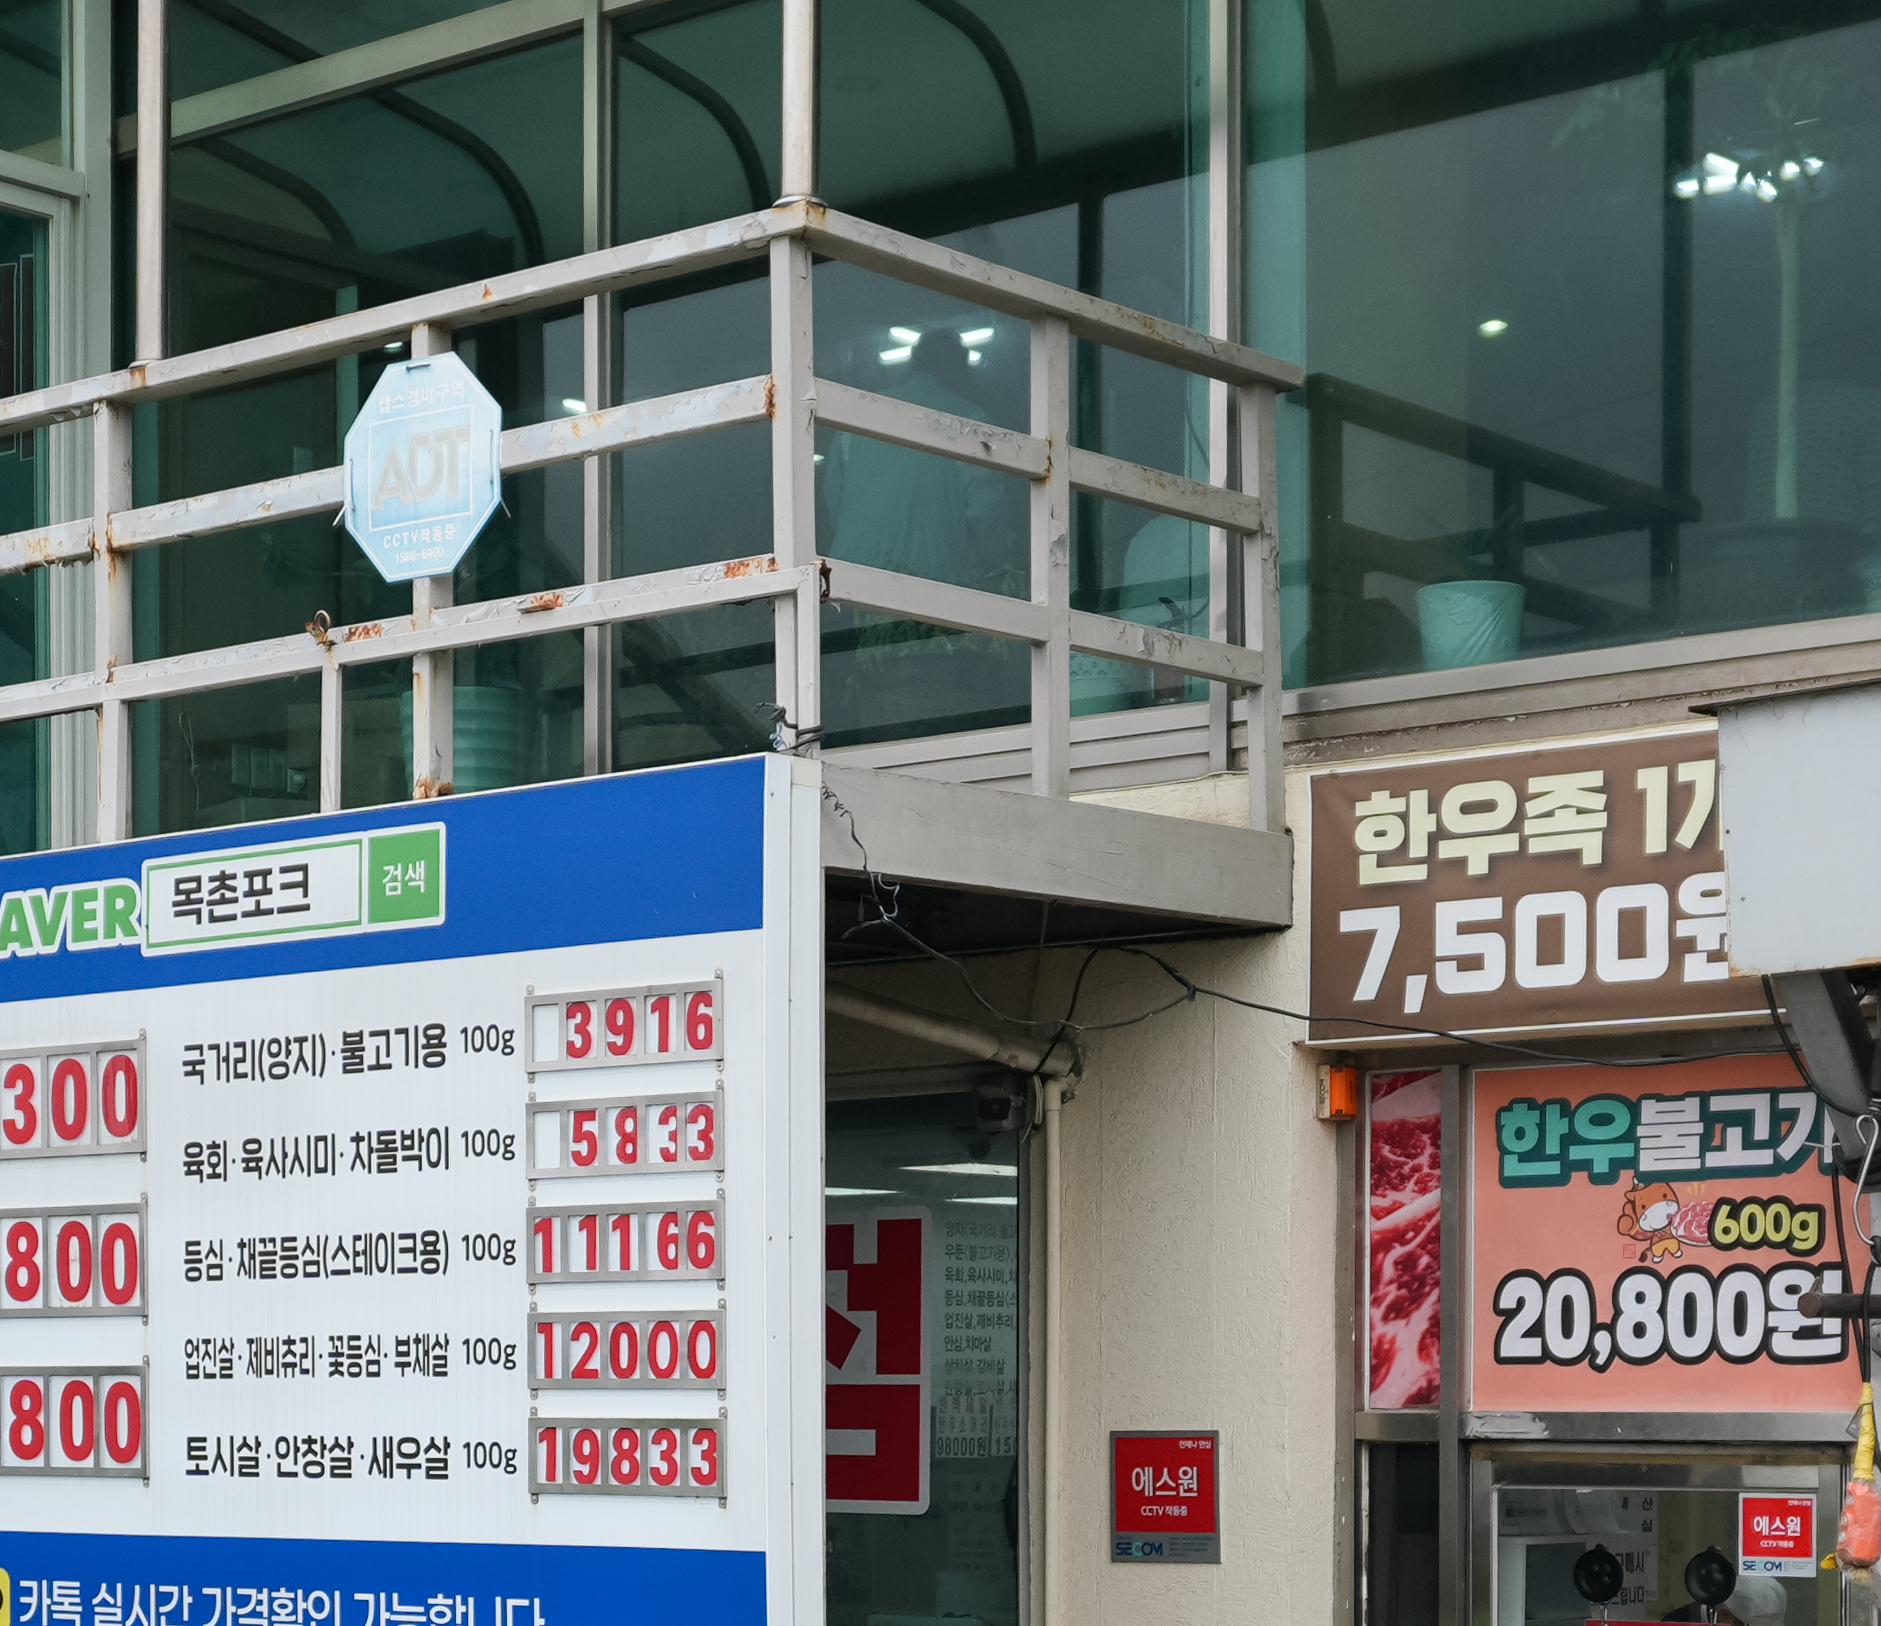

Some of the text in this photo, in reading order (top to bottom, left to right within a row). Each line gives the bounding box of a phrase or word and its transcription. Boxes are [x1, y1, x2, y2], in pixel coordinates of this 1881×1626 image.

[371, 425, 471, 510] ADT
[1353, 769, 1609, 886] 한우족
[172, 862, 311, 925] 목촌포크
[381, 860, 427, 896] 검색
[460, 1024, 515, 1057] 100g
[566, 991, 713, 1059] 3916
[460, 1130, 516, 1161] 100g
[570, 1104, 714, 1167] 5833
[1500, 1091, 1834, 1177] 한우불고기
[461, 1233, 517, 1266] 100g
[534, 1210, 716, 1273] 11166
[1714, 1202, 1819, 1250] 600g
[1499, 1268, 1842, 1366] 20,800원
[462, 1338, 517, 1370] 100g
[537, 1320, 717, 1380] 12000
[462, 1442, 518, 1474] 100g
[538, 1427, 717, 1486] 19833
[1132, 1466, 1198, 1497] 에스원
[1116, 1542, 1163, 1556] SECOM
[1753, 1516, 1801, 1537] 에스원
[1742, 1560, 1782, 1572] SECOM
